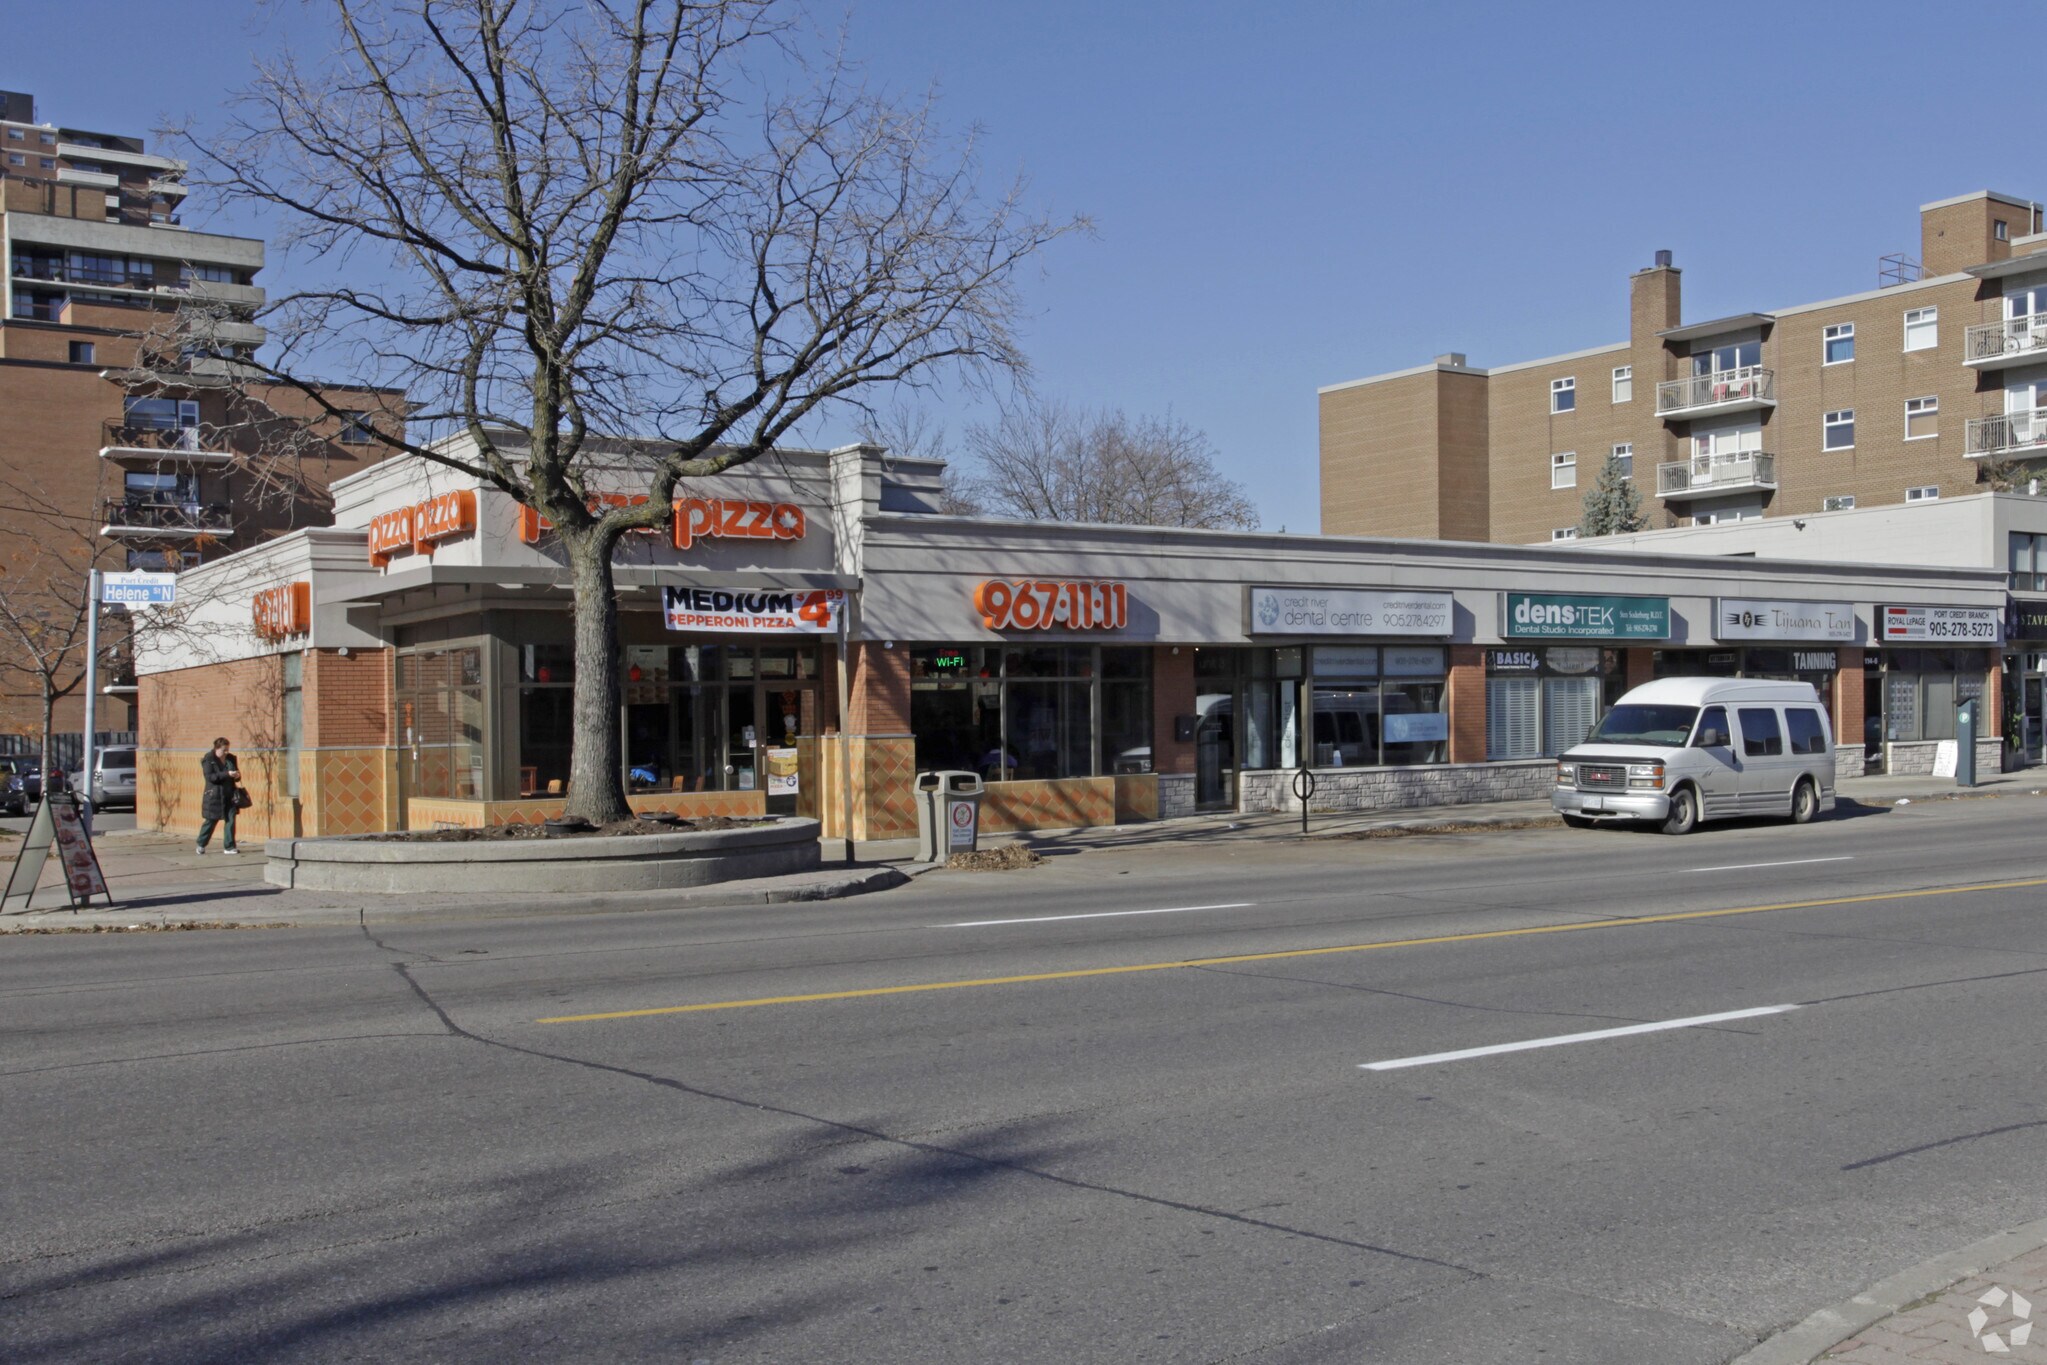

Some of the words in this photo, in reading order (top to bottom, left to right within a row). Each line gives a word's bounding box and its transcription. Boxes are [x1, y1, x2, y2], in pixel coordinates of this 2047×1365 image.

[675, 498, 806, 550] pizza
[369, 506, 412, 568] pizza
[105, 585, 150, 600] Helene
[161, 586, 172, 600] N
[666, 586, 795, 614] MEDIUM
[1283, 597, 1309, 608] credit
[1310, 597, 1328, 608] river
[667, 613, 750, 628] PEPPERONI
[752, 615, 797, 628] PIZZA
[1284, 609, 1327, 626] dental
[1330, 610, 1373, 627] centre
[1771, 609, 1822, 634] Tijuana
[1825, 611, 1851, 630] Tan
[1888, 616, 1906, 626] ROYAL
[1934, 610, 1948, 619] PORT
[1949, 611, 1967, 619] CREDIT
[1968, 611, 1990, 620] BRANCH
[1515, 625, 1540, 634] Dental
[1541, 625, 1567, 634] Studio
[1568, 626, 1615, 636] Incorporated
[1929, 621, 1994, 637] 905-278-5273
[1496, 652, 1531, 665] BASIC
[1793, 652, 1837, 670] TANNING
